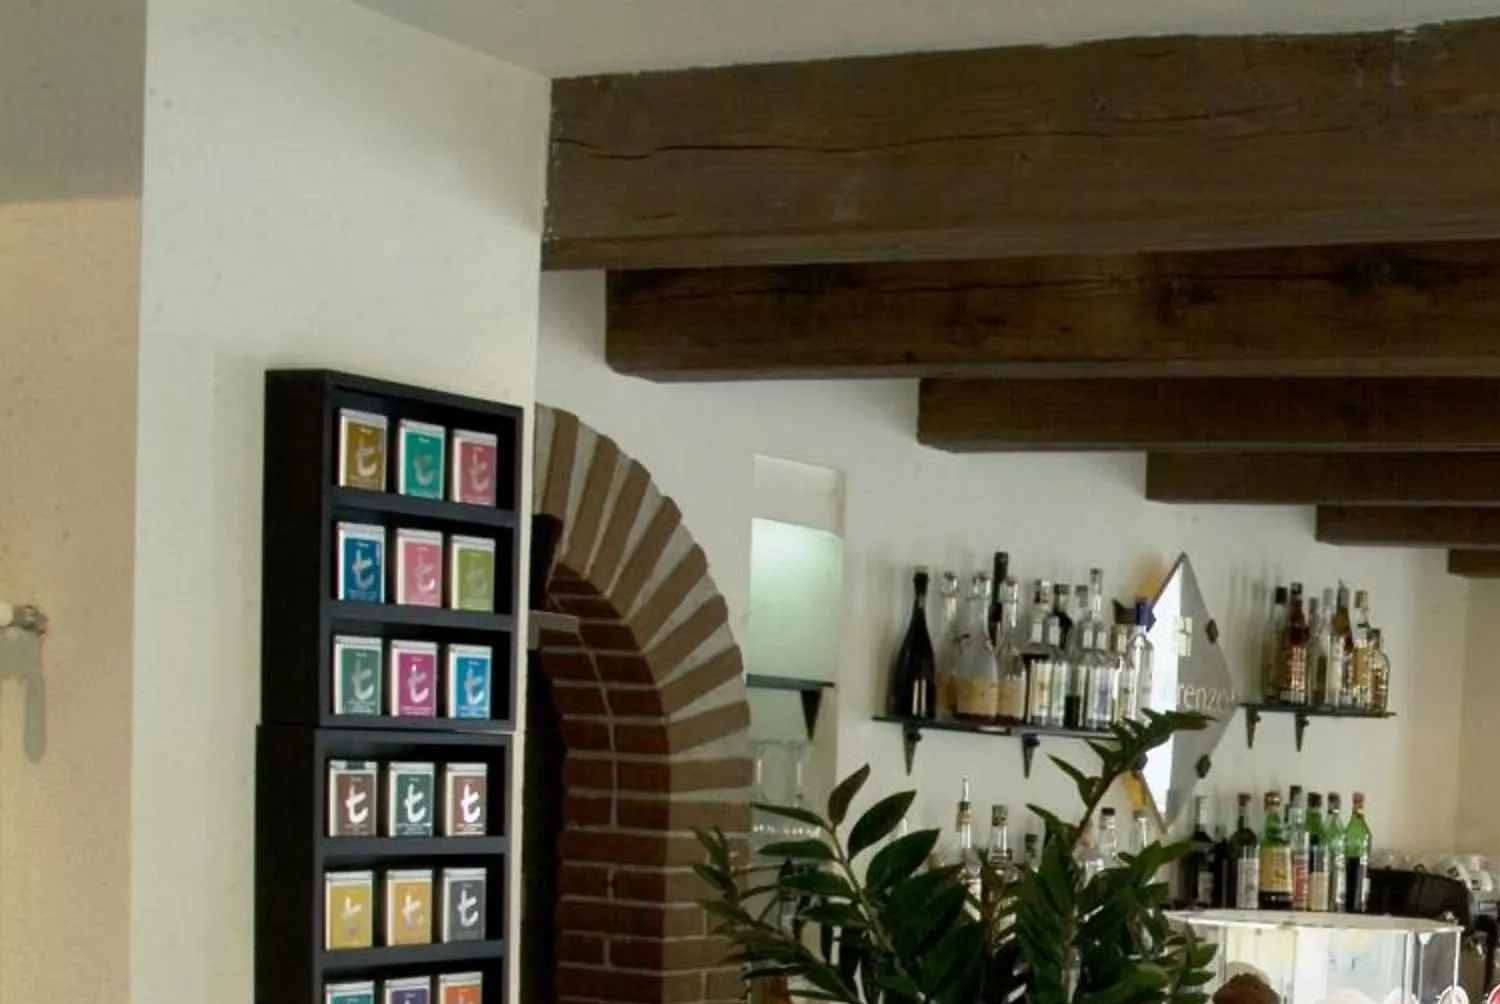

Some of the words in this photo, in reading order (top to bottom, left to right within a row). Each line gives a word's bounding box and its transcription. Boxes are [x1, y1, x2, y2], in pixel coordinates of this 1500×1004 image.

[408, 664, 429, 703] t
[345, 784, 369, 824] t
[404, 784, 427, 823] t
[461, 784, 481, 823] t
[457, 889, 479, 927] t
